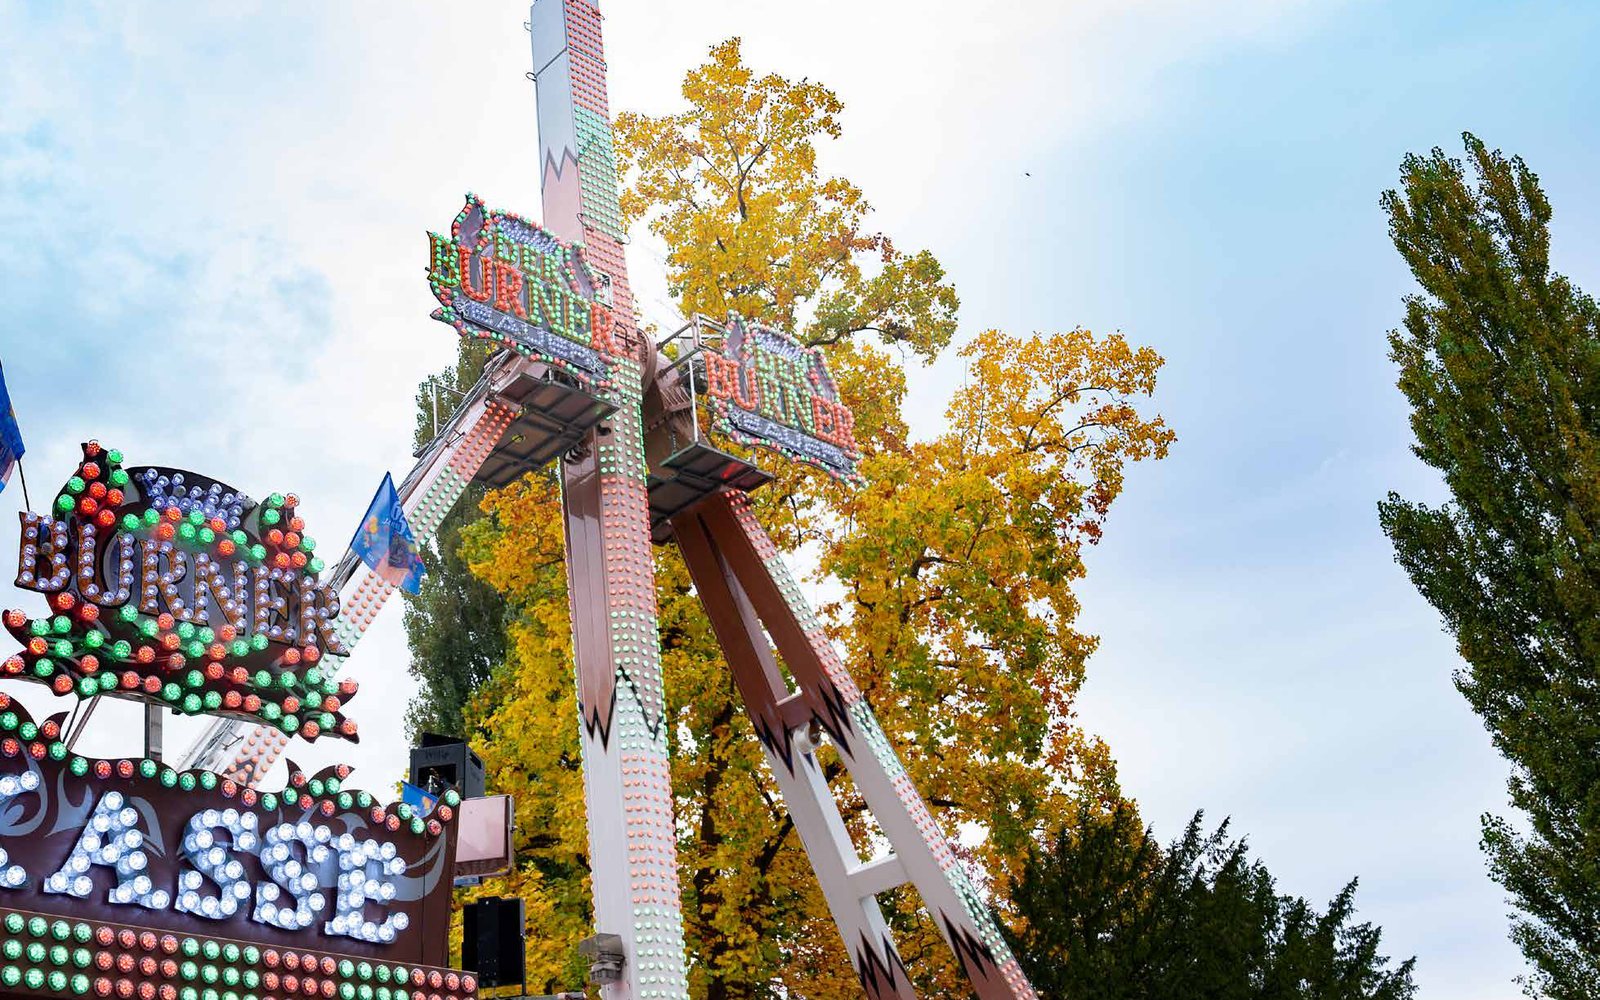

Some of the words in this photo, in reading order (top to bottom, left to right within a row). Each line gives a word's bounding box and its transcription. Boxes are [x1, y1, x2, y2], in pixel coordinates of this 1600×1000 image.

[426, 231, 621, 356] BURNER
[702, 351, 858, 450] BURNER
[14, 511, 350, 657] BURNER
